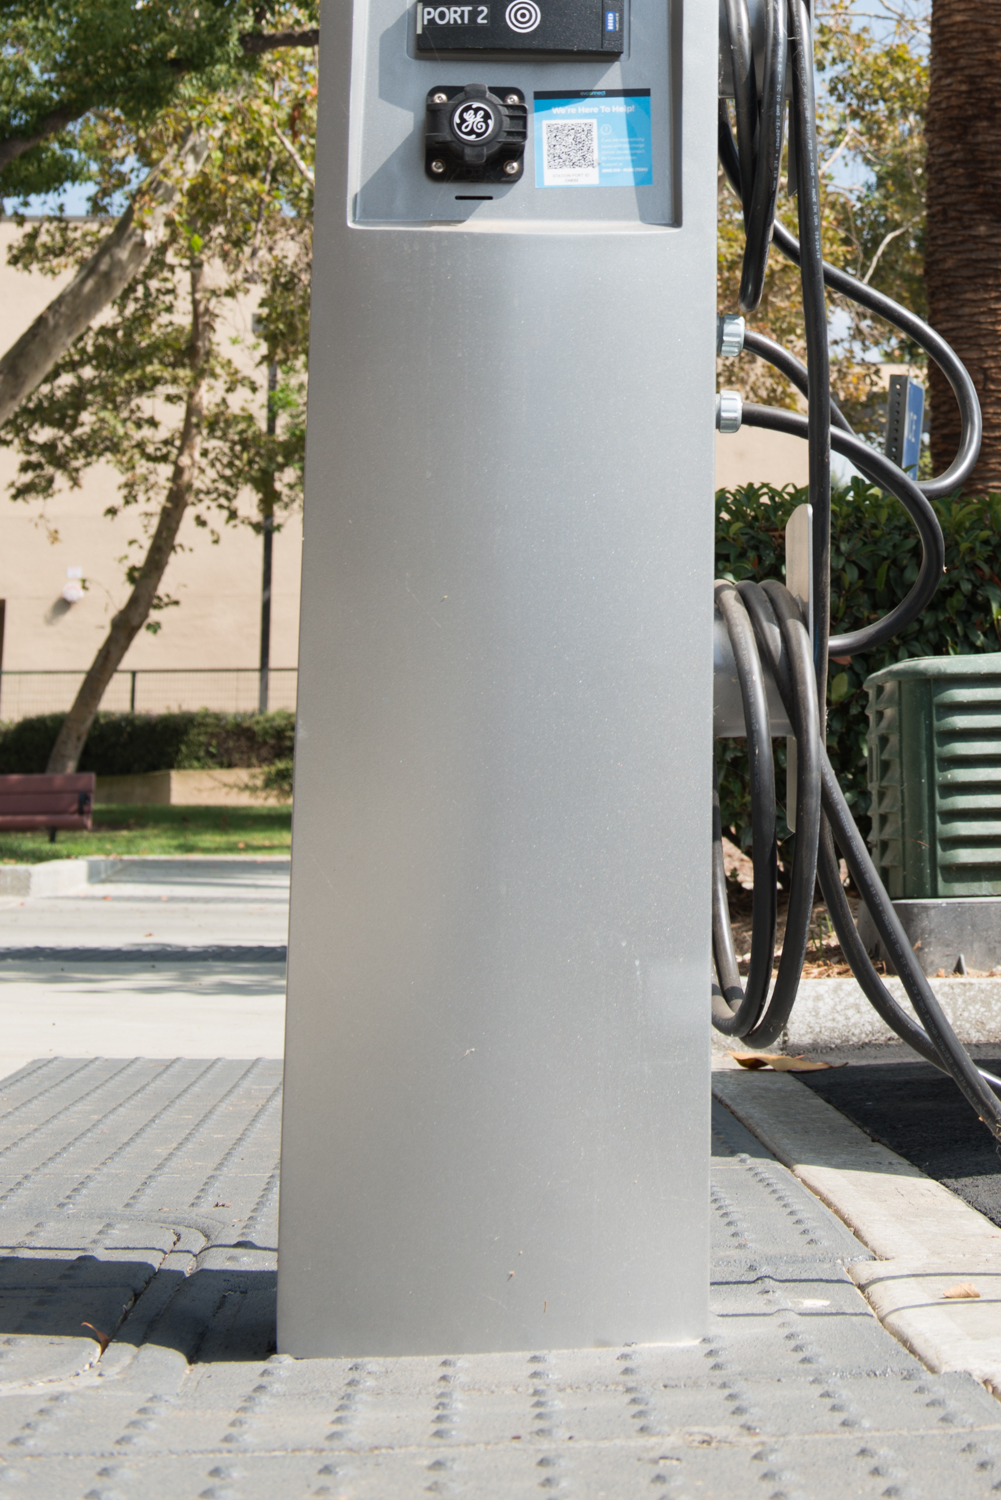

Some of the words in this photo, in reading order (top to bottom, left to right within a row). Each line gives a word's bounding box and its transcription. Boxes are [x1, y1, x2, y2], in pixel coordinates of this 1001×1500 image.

[423, 6, 472, 25] PORT
[476, 6, 488, 24] 2
[552, 106, 576, 114] We're
[578, 106, 599, 114] Here
[600, 105, 610, 113] To
[612, 105, 635, 113] Help!
